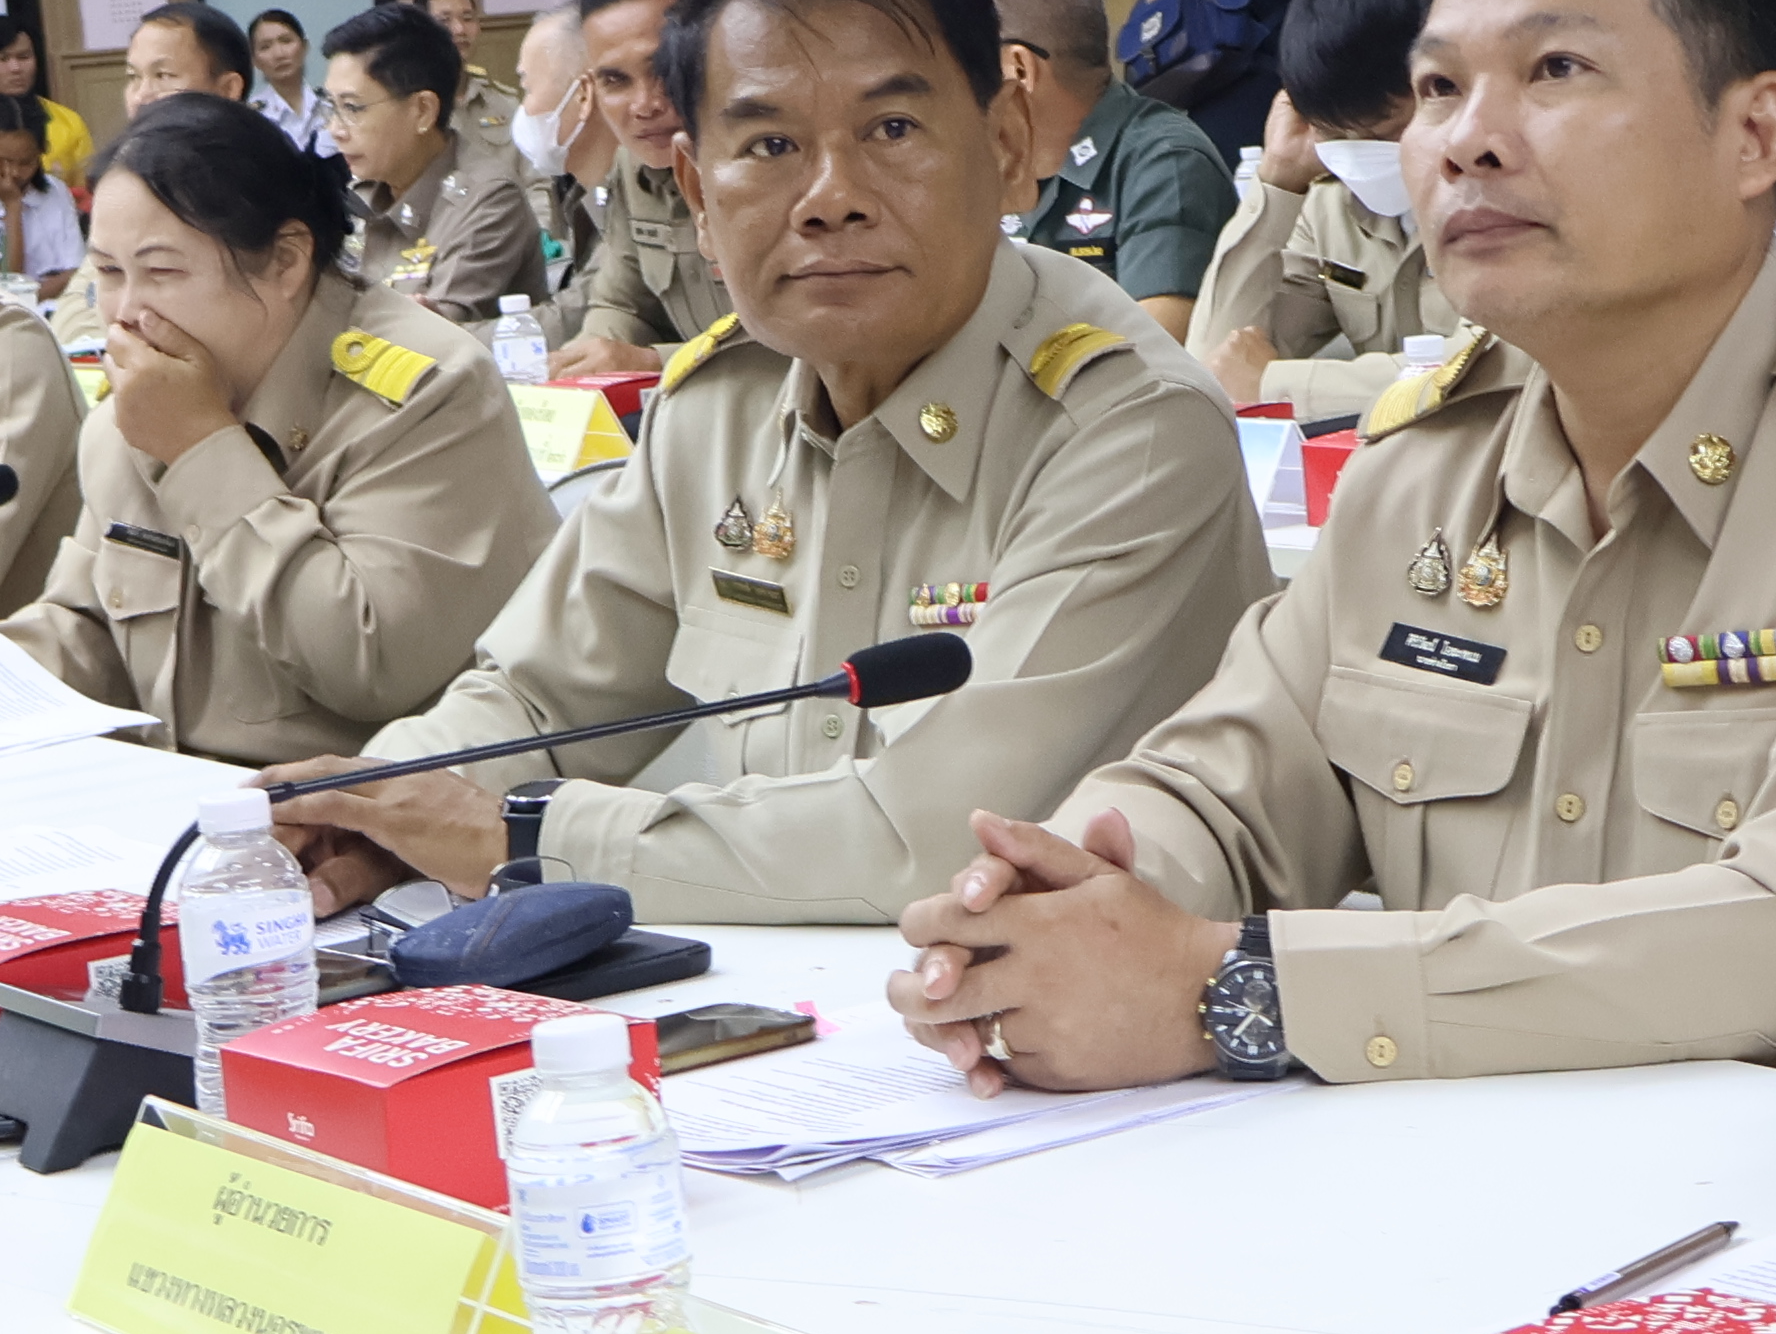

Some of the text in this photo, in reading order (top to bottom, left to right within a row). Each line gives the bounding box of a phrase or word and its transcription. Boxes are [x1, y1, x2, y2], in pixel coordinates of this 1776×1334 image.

[323, 1035, 429, 1068] SRIFA
[325, 1018, 471, 1055] BAKERY
[212, 1172, 333, 1246] ผู้อำนวยการ
